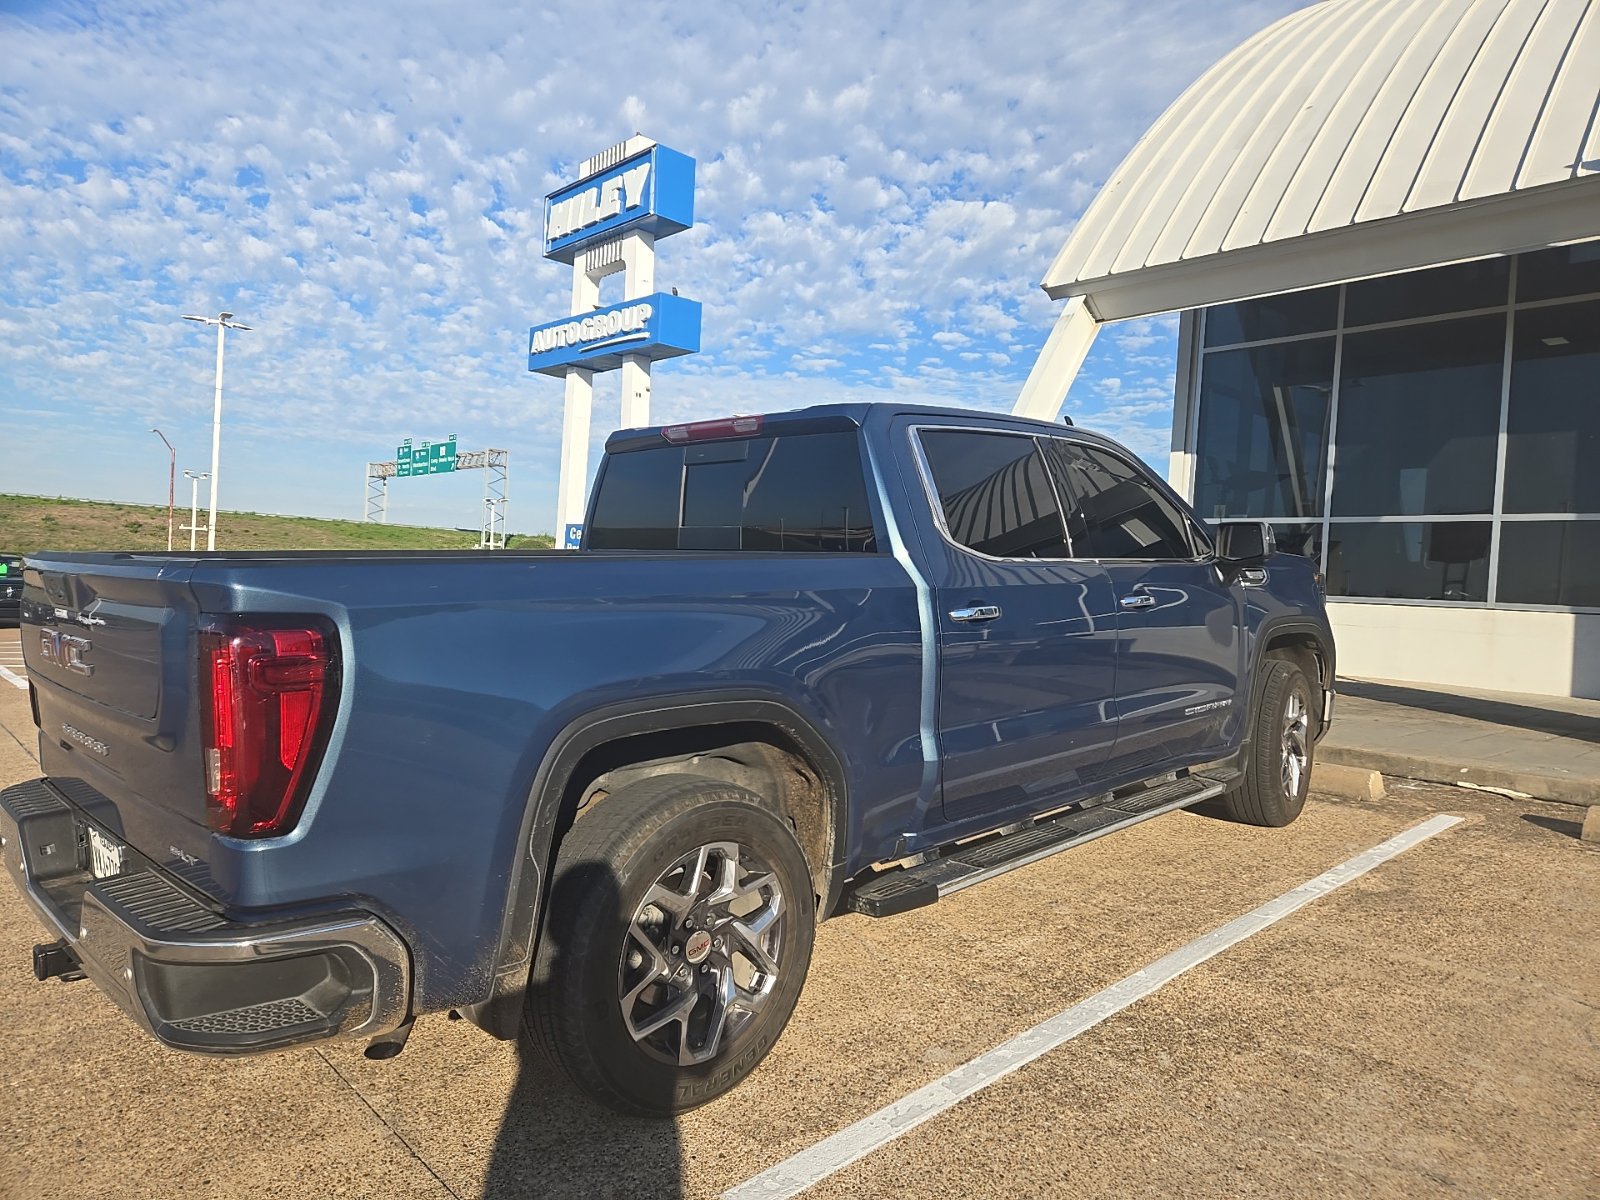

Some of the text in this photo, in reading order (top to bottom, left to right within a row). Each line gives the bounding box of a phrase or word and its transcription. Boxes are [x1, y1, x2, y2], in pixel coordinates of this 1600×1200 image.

[547, 162, 651, 241] HILEY
[530, 303, 654, 355] AUTOGROUP
[688, 938, 710, 957] GMC
